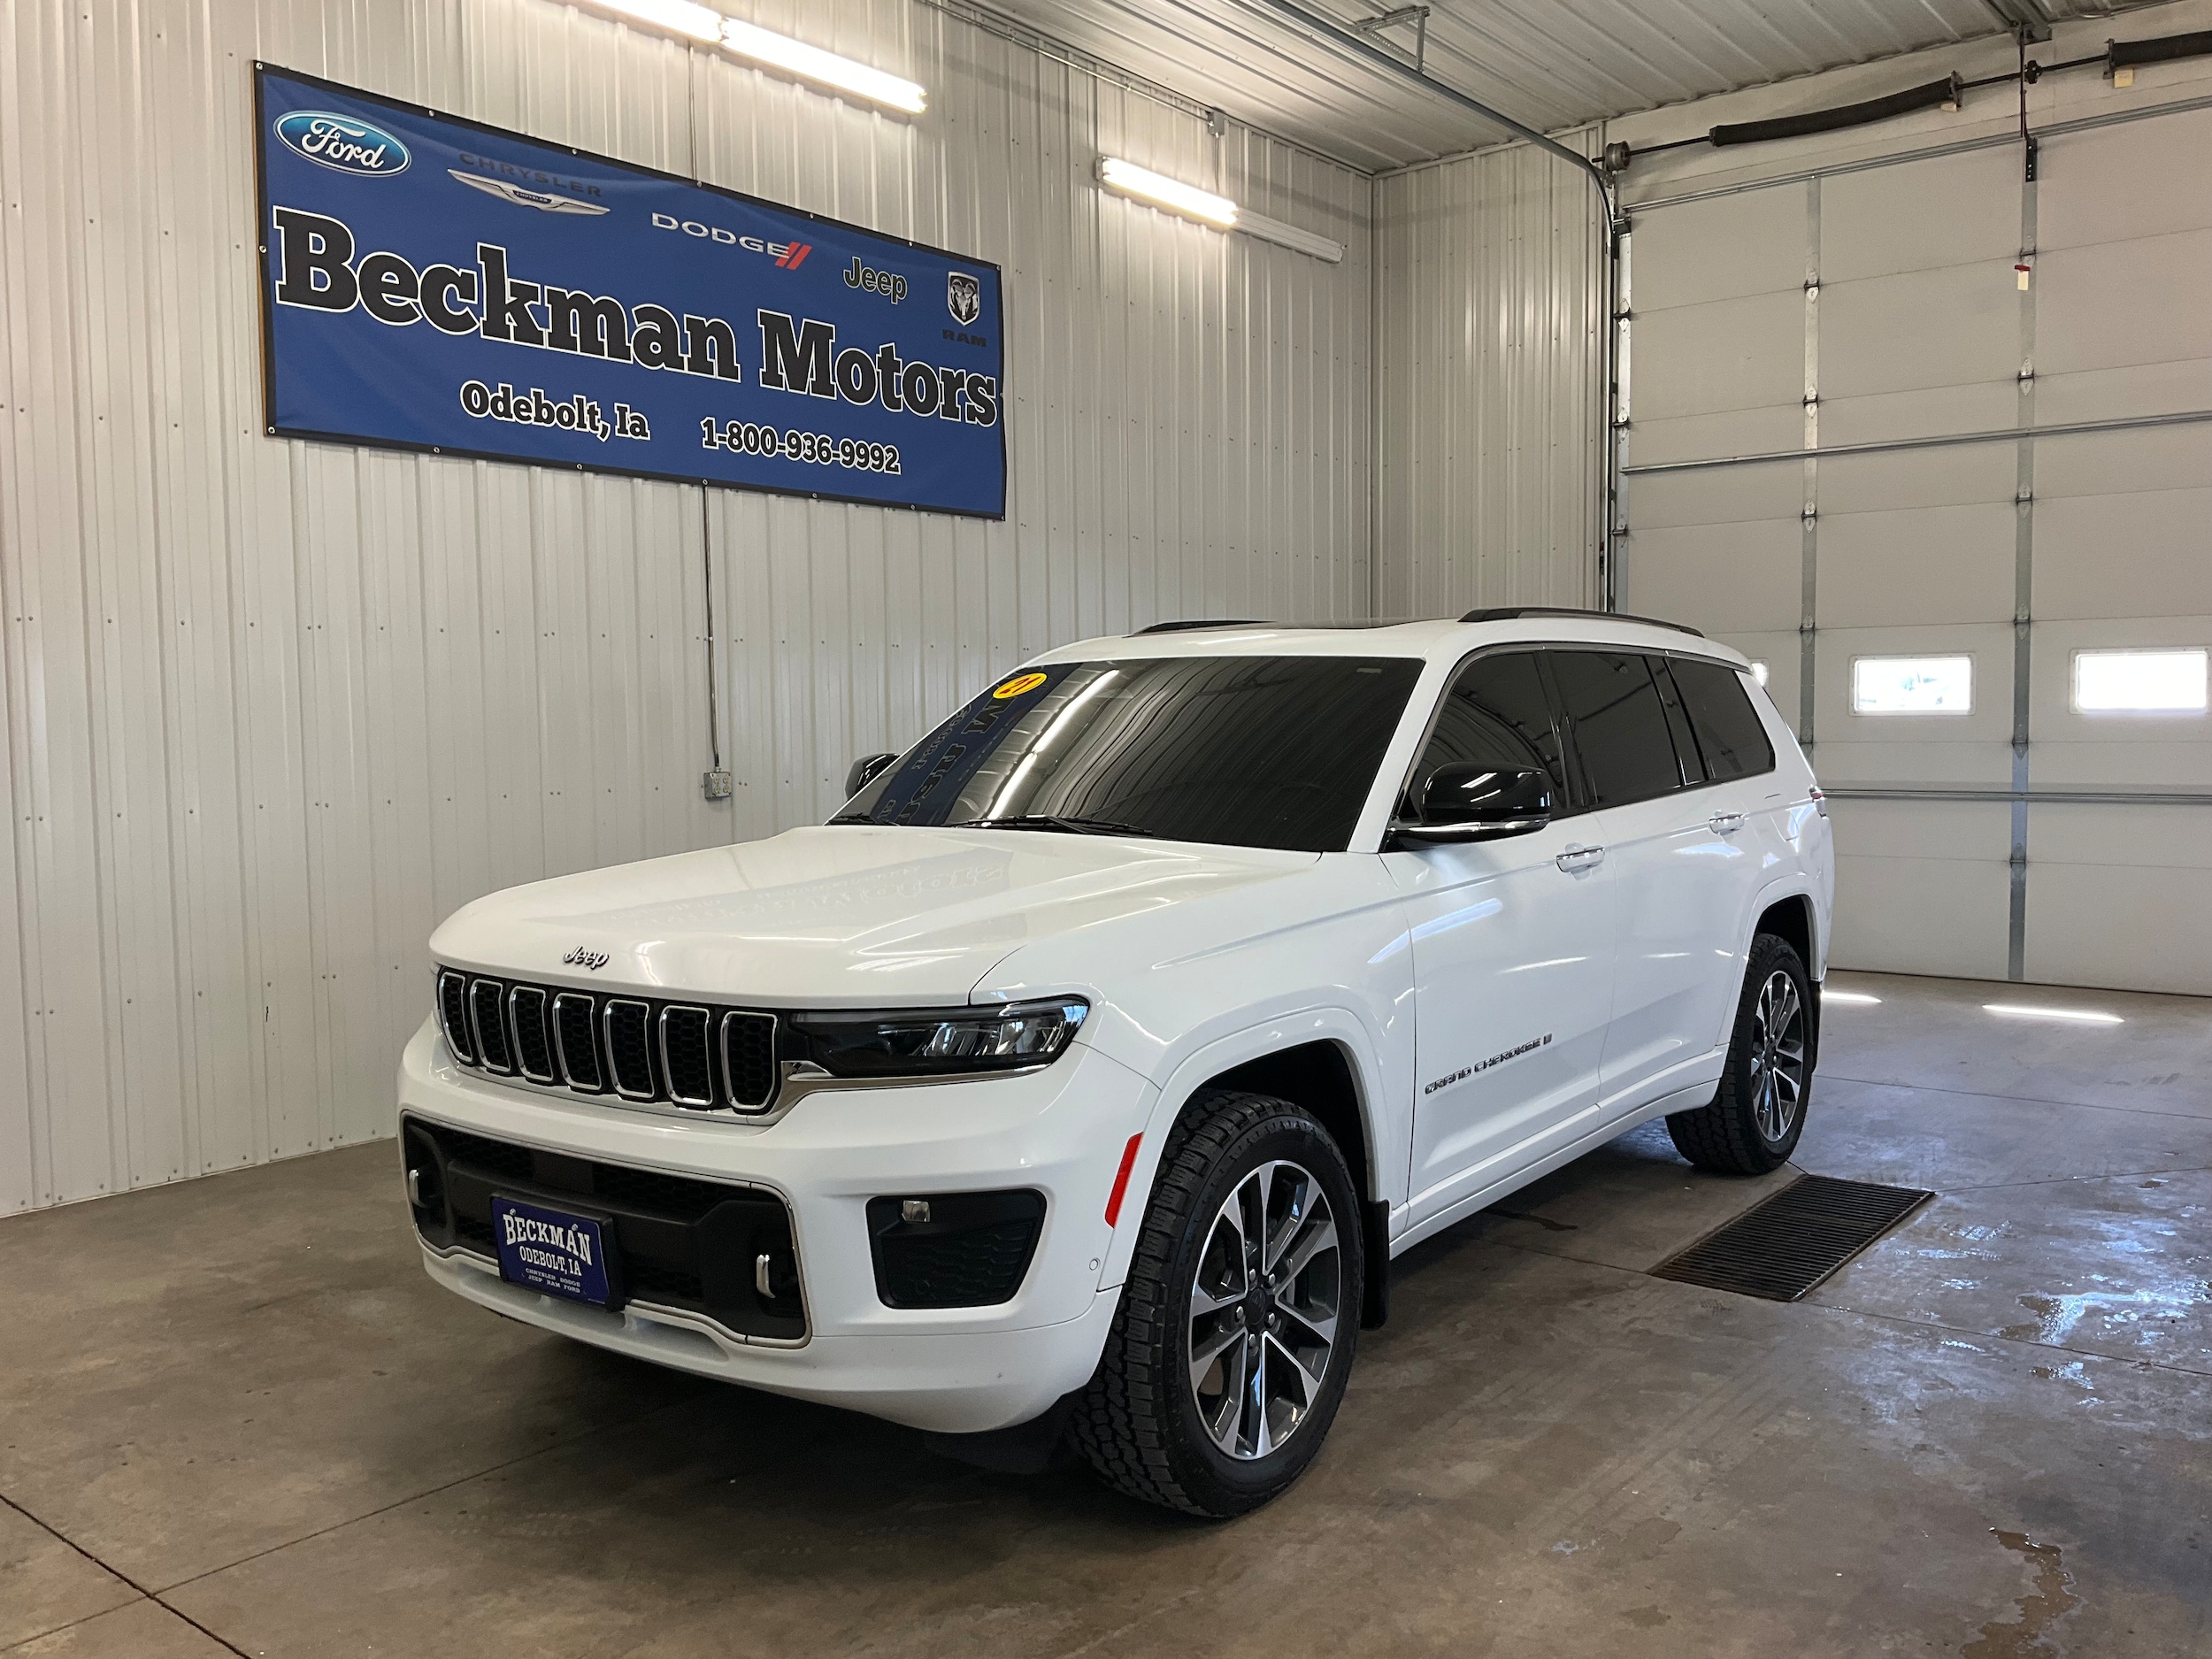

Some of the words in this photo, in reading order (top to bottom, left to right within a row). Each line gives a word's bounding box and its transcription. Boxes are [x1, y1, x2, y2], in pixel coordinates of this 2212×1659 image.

[301, 118, 386, 169] Ford
[459, 152, 602, 197] CHRYSLER
[651, 212, 791, 259] DODGE
[842, 257, 908, 305] Jeep
[273, 204, 741, 382] Beckman
[757, 307, 998, 427] Motors
[941, 328, 987, 348] RAM
[460, 380, 611, 442] Odebolt,
[614, 403, 651, 441] Ia
[700, 417, 902, 475] 1-800-936-9992
[563, 945, 610, 970] Jeep
[1425, 1066, 1472, 1094] GRAND
[1474, 1037, 1541, 1073] CHEROKEE
[503, 1213, 593, 1266] BECKMAN
[519, 1245, 568, 1275] ODEBOLT,
[568, 1258, 582, 1276] IA
[526, 1267, 557, 1281] CHRYSLER
[559, 1277, 581, 1287] DODGE
[528, 1274, 543, 1283] JEEP
[546, 1279, 561, 1288] RAM
[564, 1284, 580, 1294] FORD
